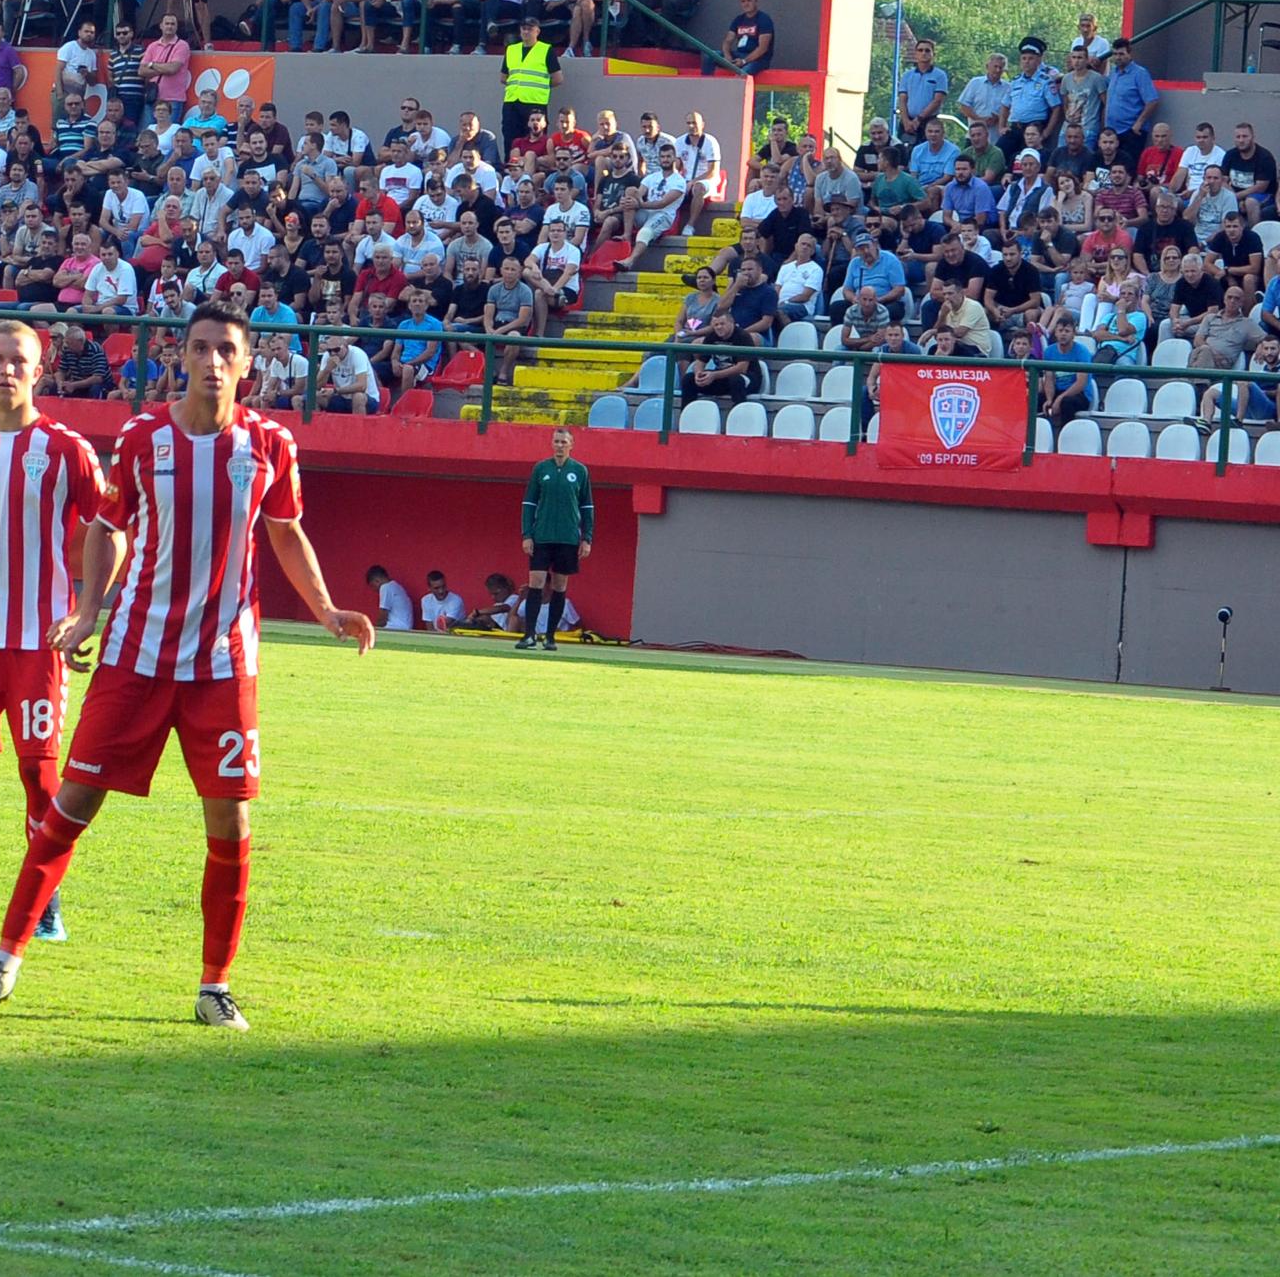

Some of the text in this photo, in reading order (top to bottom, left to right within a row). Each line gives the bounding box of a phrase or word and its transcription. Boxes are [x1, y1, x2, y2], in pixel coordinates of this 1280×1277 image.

[917, 369, 992, 382] ФК ЗВИЈЕЗДА
[935, 453, 978, 465] БРГУЛЕ
[20, 698, 54, 740] 18
[218, 729, 260, 778] 23
